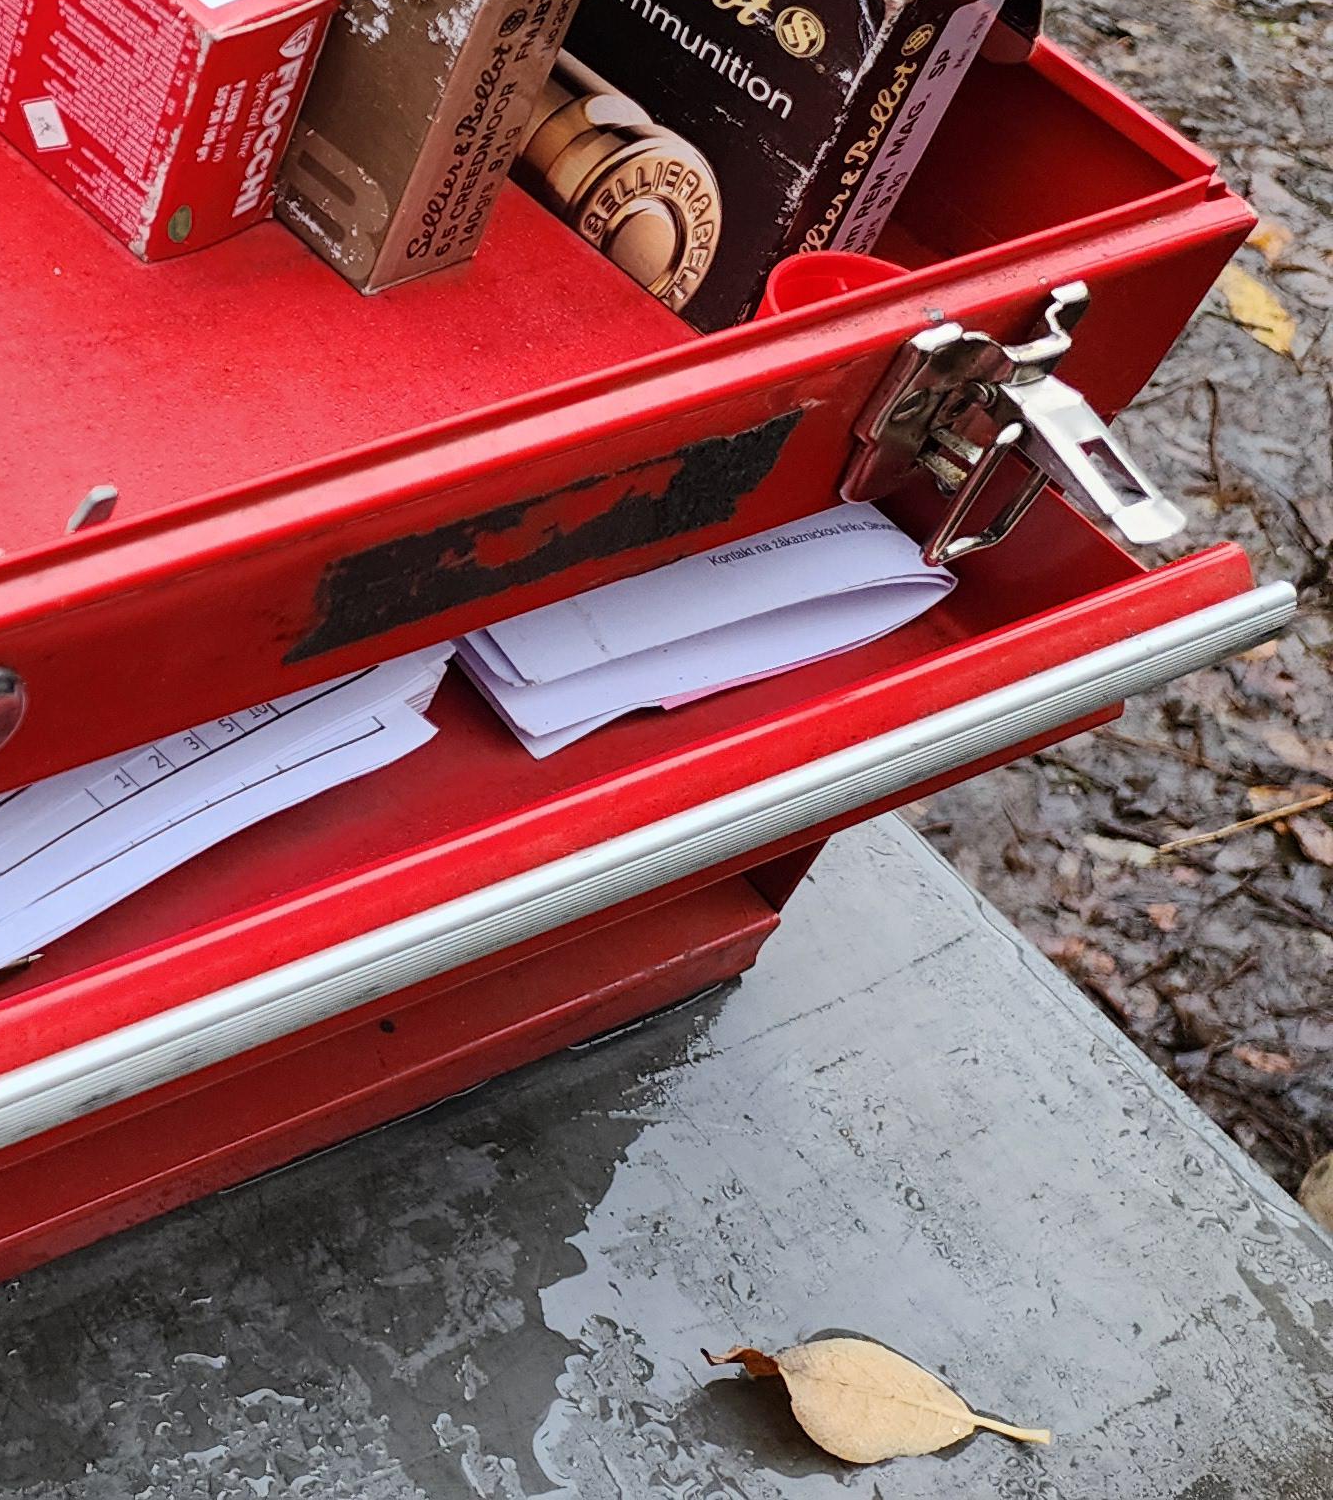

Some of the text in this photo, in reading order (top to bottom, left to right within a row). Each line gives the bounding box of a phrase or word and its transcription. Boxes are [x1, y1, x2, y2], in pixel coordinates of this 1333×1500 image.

[232, 57, 303, 216] FIOCCHI
[246, 71, 274, 126] Special
[407, 44, 511, 258] Sellier & Bellot
[452, 82, 515, 217] CREEDMOOR
[800, 58, 918, 258] llier & Bellot
[853, 162, 894, 221] REM.
[884, 92, 932, 160] MAG.
[928, 47, 950, 80] SP
[458, 182, 492, 245] 140grs
[708, 545, 754, 567] Kontakt
[754, 541, 772, 553] na
[114, 774, 131, 789] 1
[148, 755, 167, 769] 2
[183, 736, 200, 752] 3
[217, 717, 234, 732] 5
